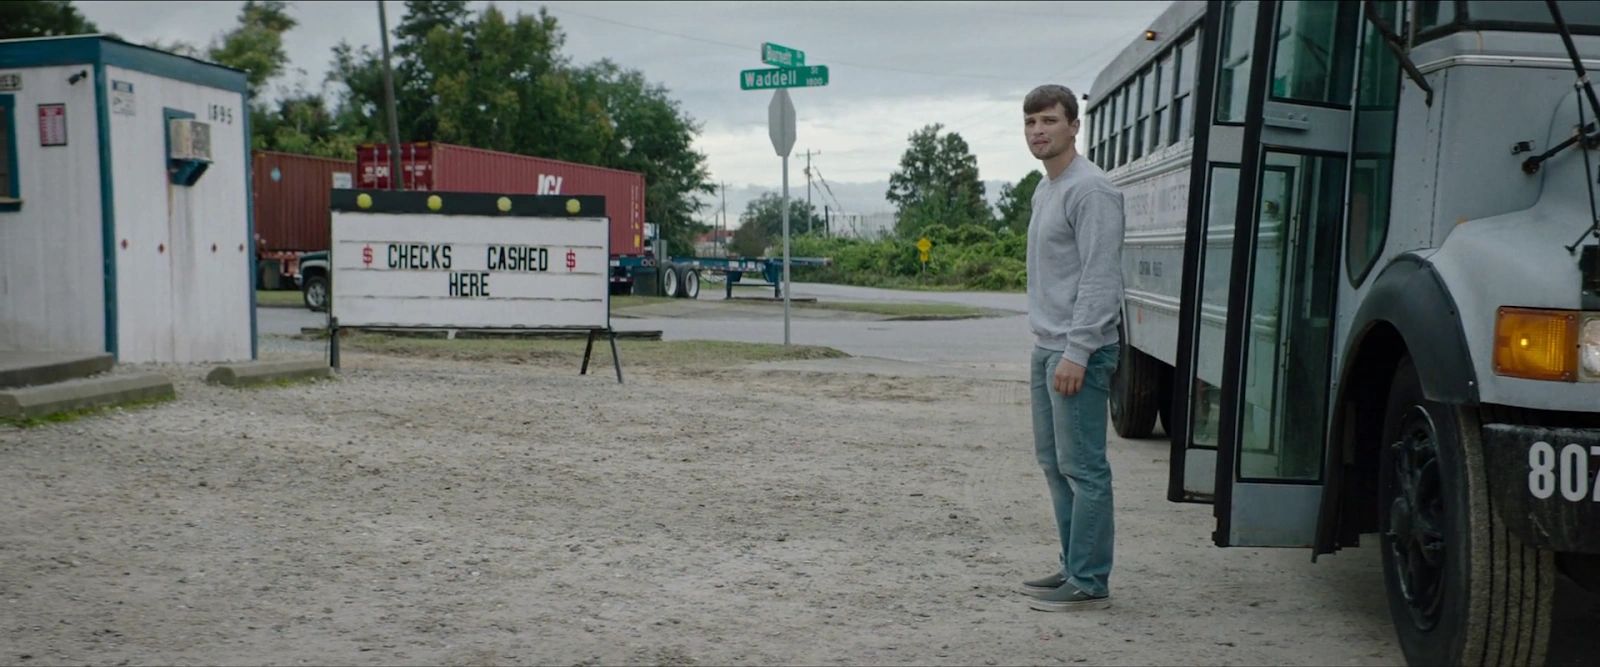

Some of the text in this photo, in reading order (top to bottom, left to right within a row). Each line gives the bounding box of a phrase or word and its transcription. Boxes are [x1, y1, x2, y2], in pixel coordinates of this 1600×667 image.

[744, 70, 797, 87] Waddell
[363, 244, 576, 272] $ CHECKS CASHED $
[449, 273, 490, 297] HERE
